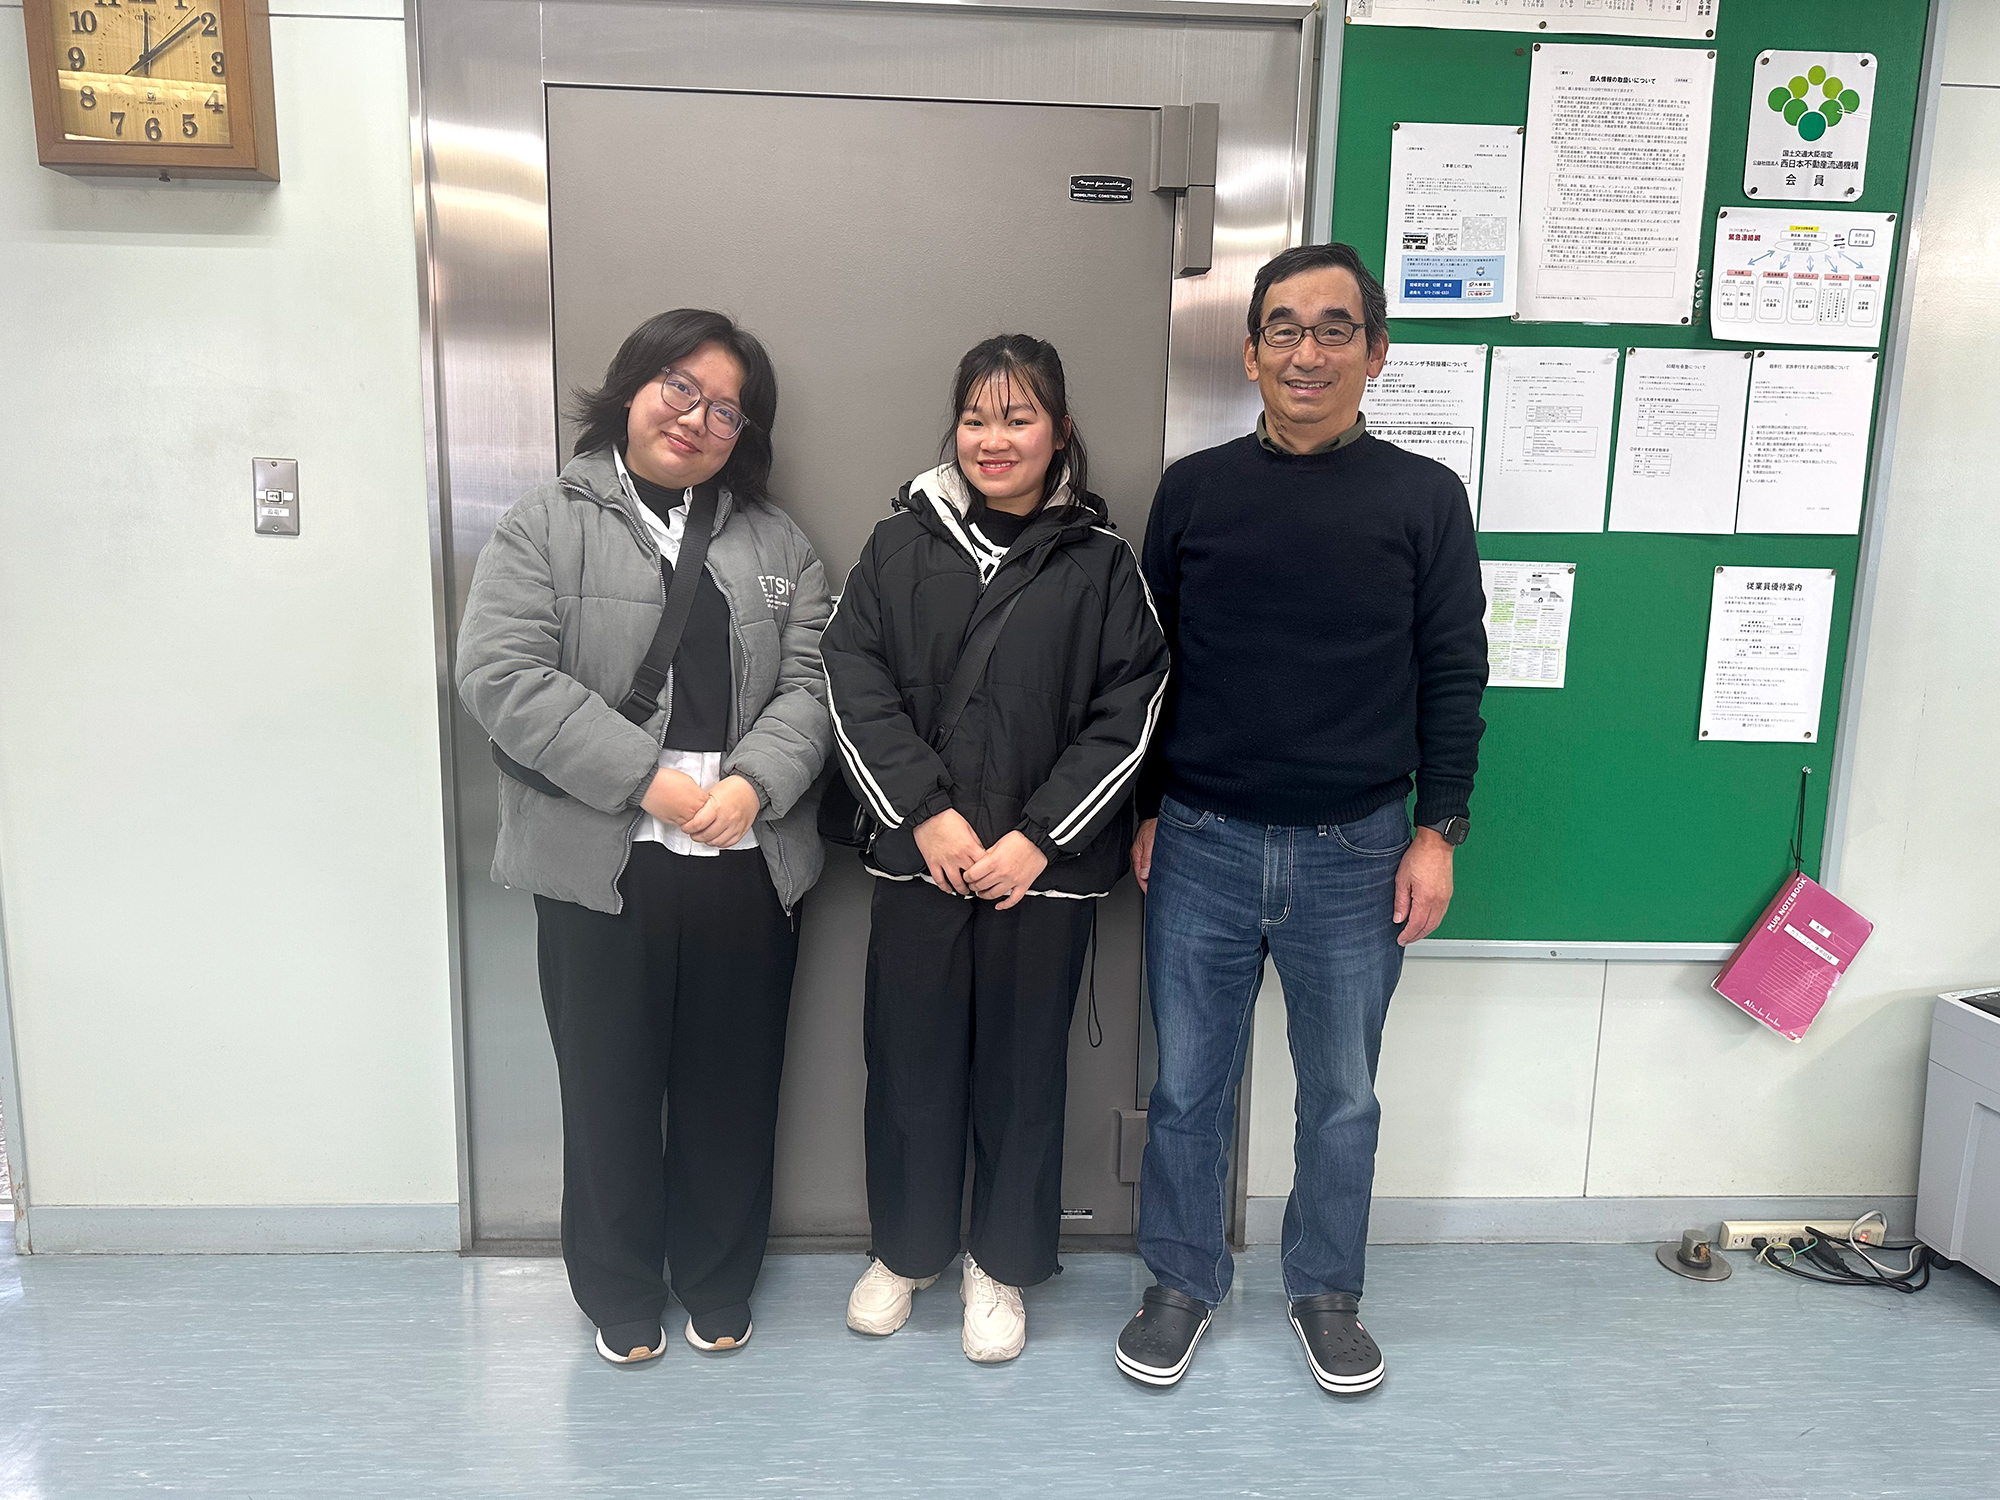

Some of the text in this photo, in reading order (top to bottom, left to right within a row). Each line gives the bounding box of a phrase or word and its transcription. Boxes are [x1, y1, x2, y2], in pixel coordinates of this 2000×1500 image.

[69, 10, 97, 34] 10
[201, 12, 217, 37] 2
[68, 47, 85, 71] 9
[211, 52, 225, 77] 3
[80, 85, 97, 109] 8
[204, 90, 224, 113] 4
[110, 112, 126, 136] 7
[145, 118, 162, 141] 6
[182, 113, 198, 137] 5
[1780, 159, 1859, 170] 西日本不動産流通機構
[1782, 149, 1834, 158] 国土交通大臣指定
[1728, 233, 1761, 242] 緊急連絡網
[1746, 582, 1803, 592] 従業員優待案内
[1766, 877, 1808, 932] PLUS NOTEBOOK
